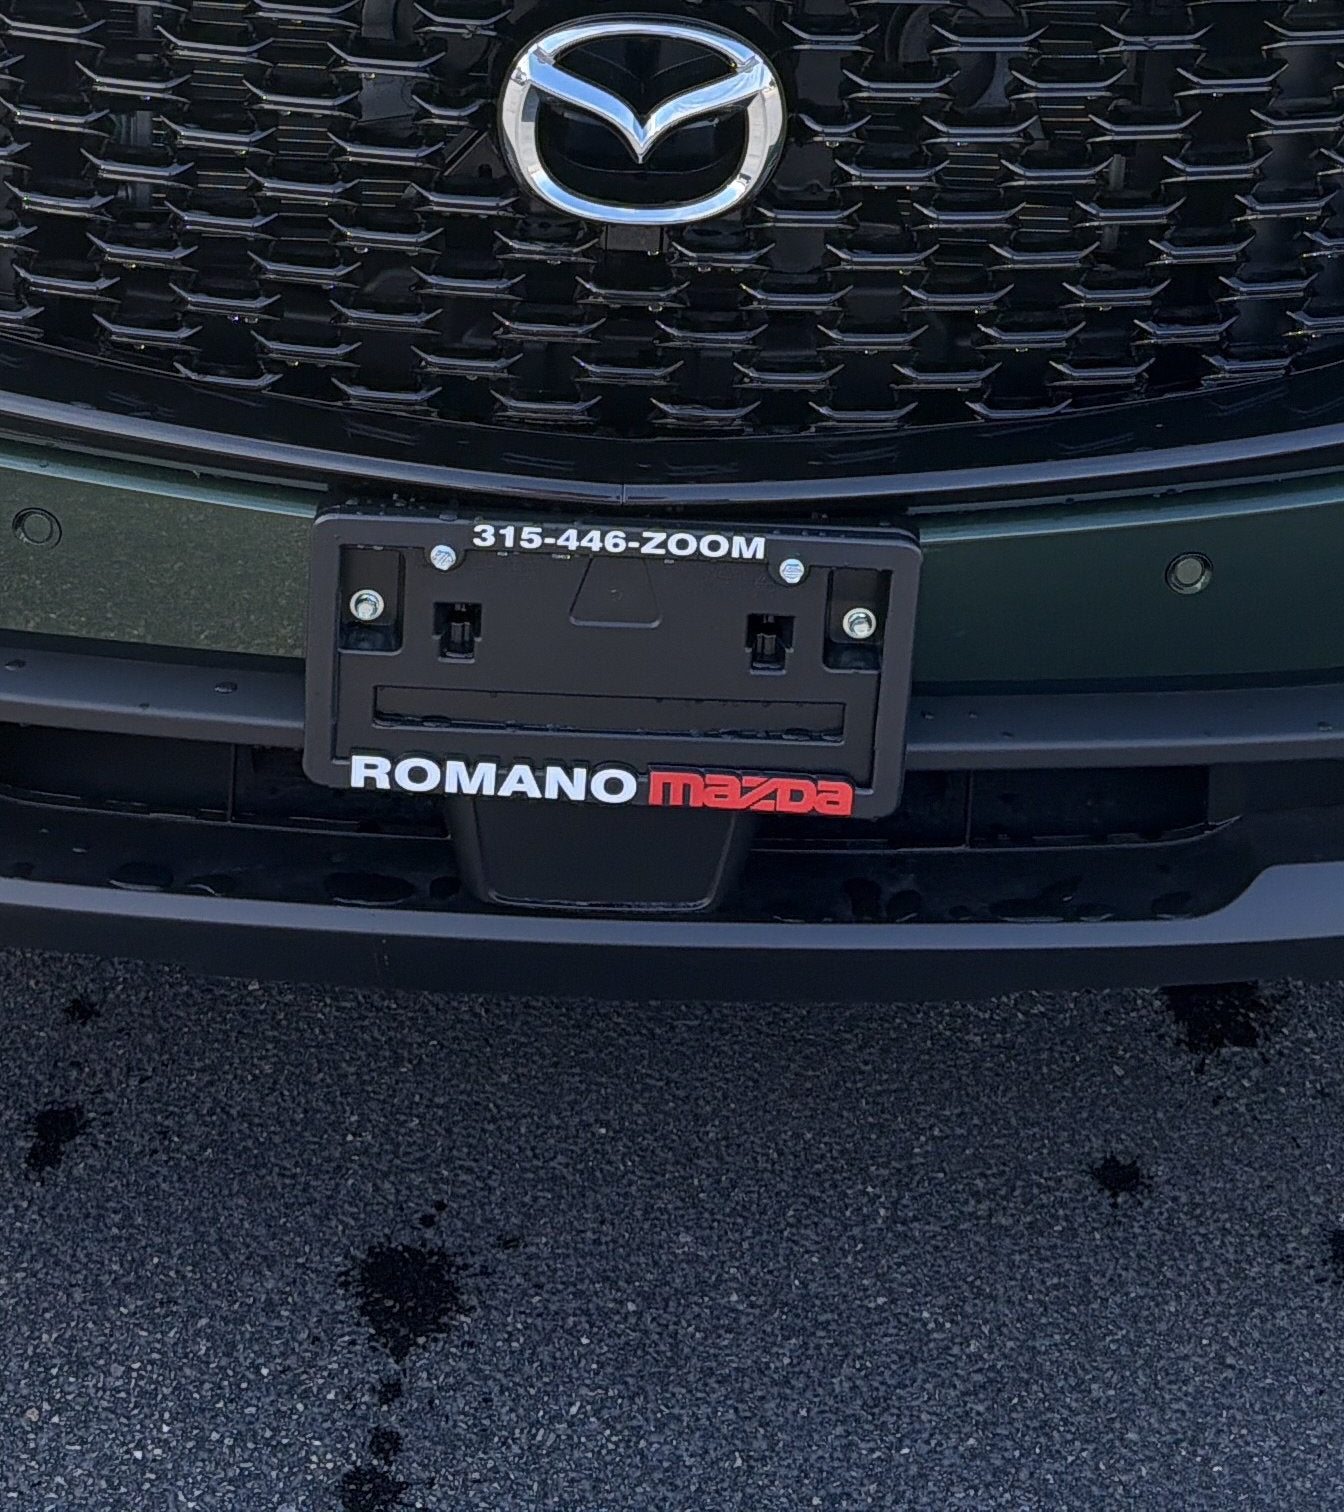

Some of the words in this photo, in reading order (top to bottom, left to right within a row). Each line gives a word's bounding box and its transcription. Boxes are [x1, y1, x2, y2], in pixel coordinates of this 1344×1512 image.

[473, 524, 766, 560] 315-446-ZOOM
[350, 754, 637, 805] ROMANO
[648, 771, 853, 816] mazda
